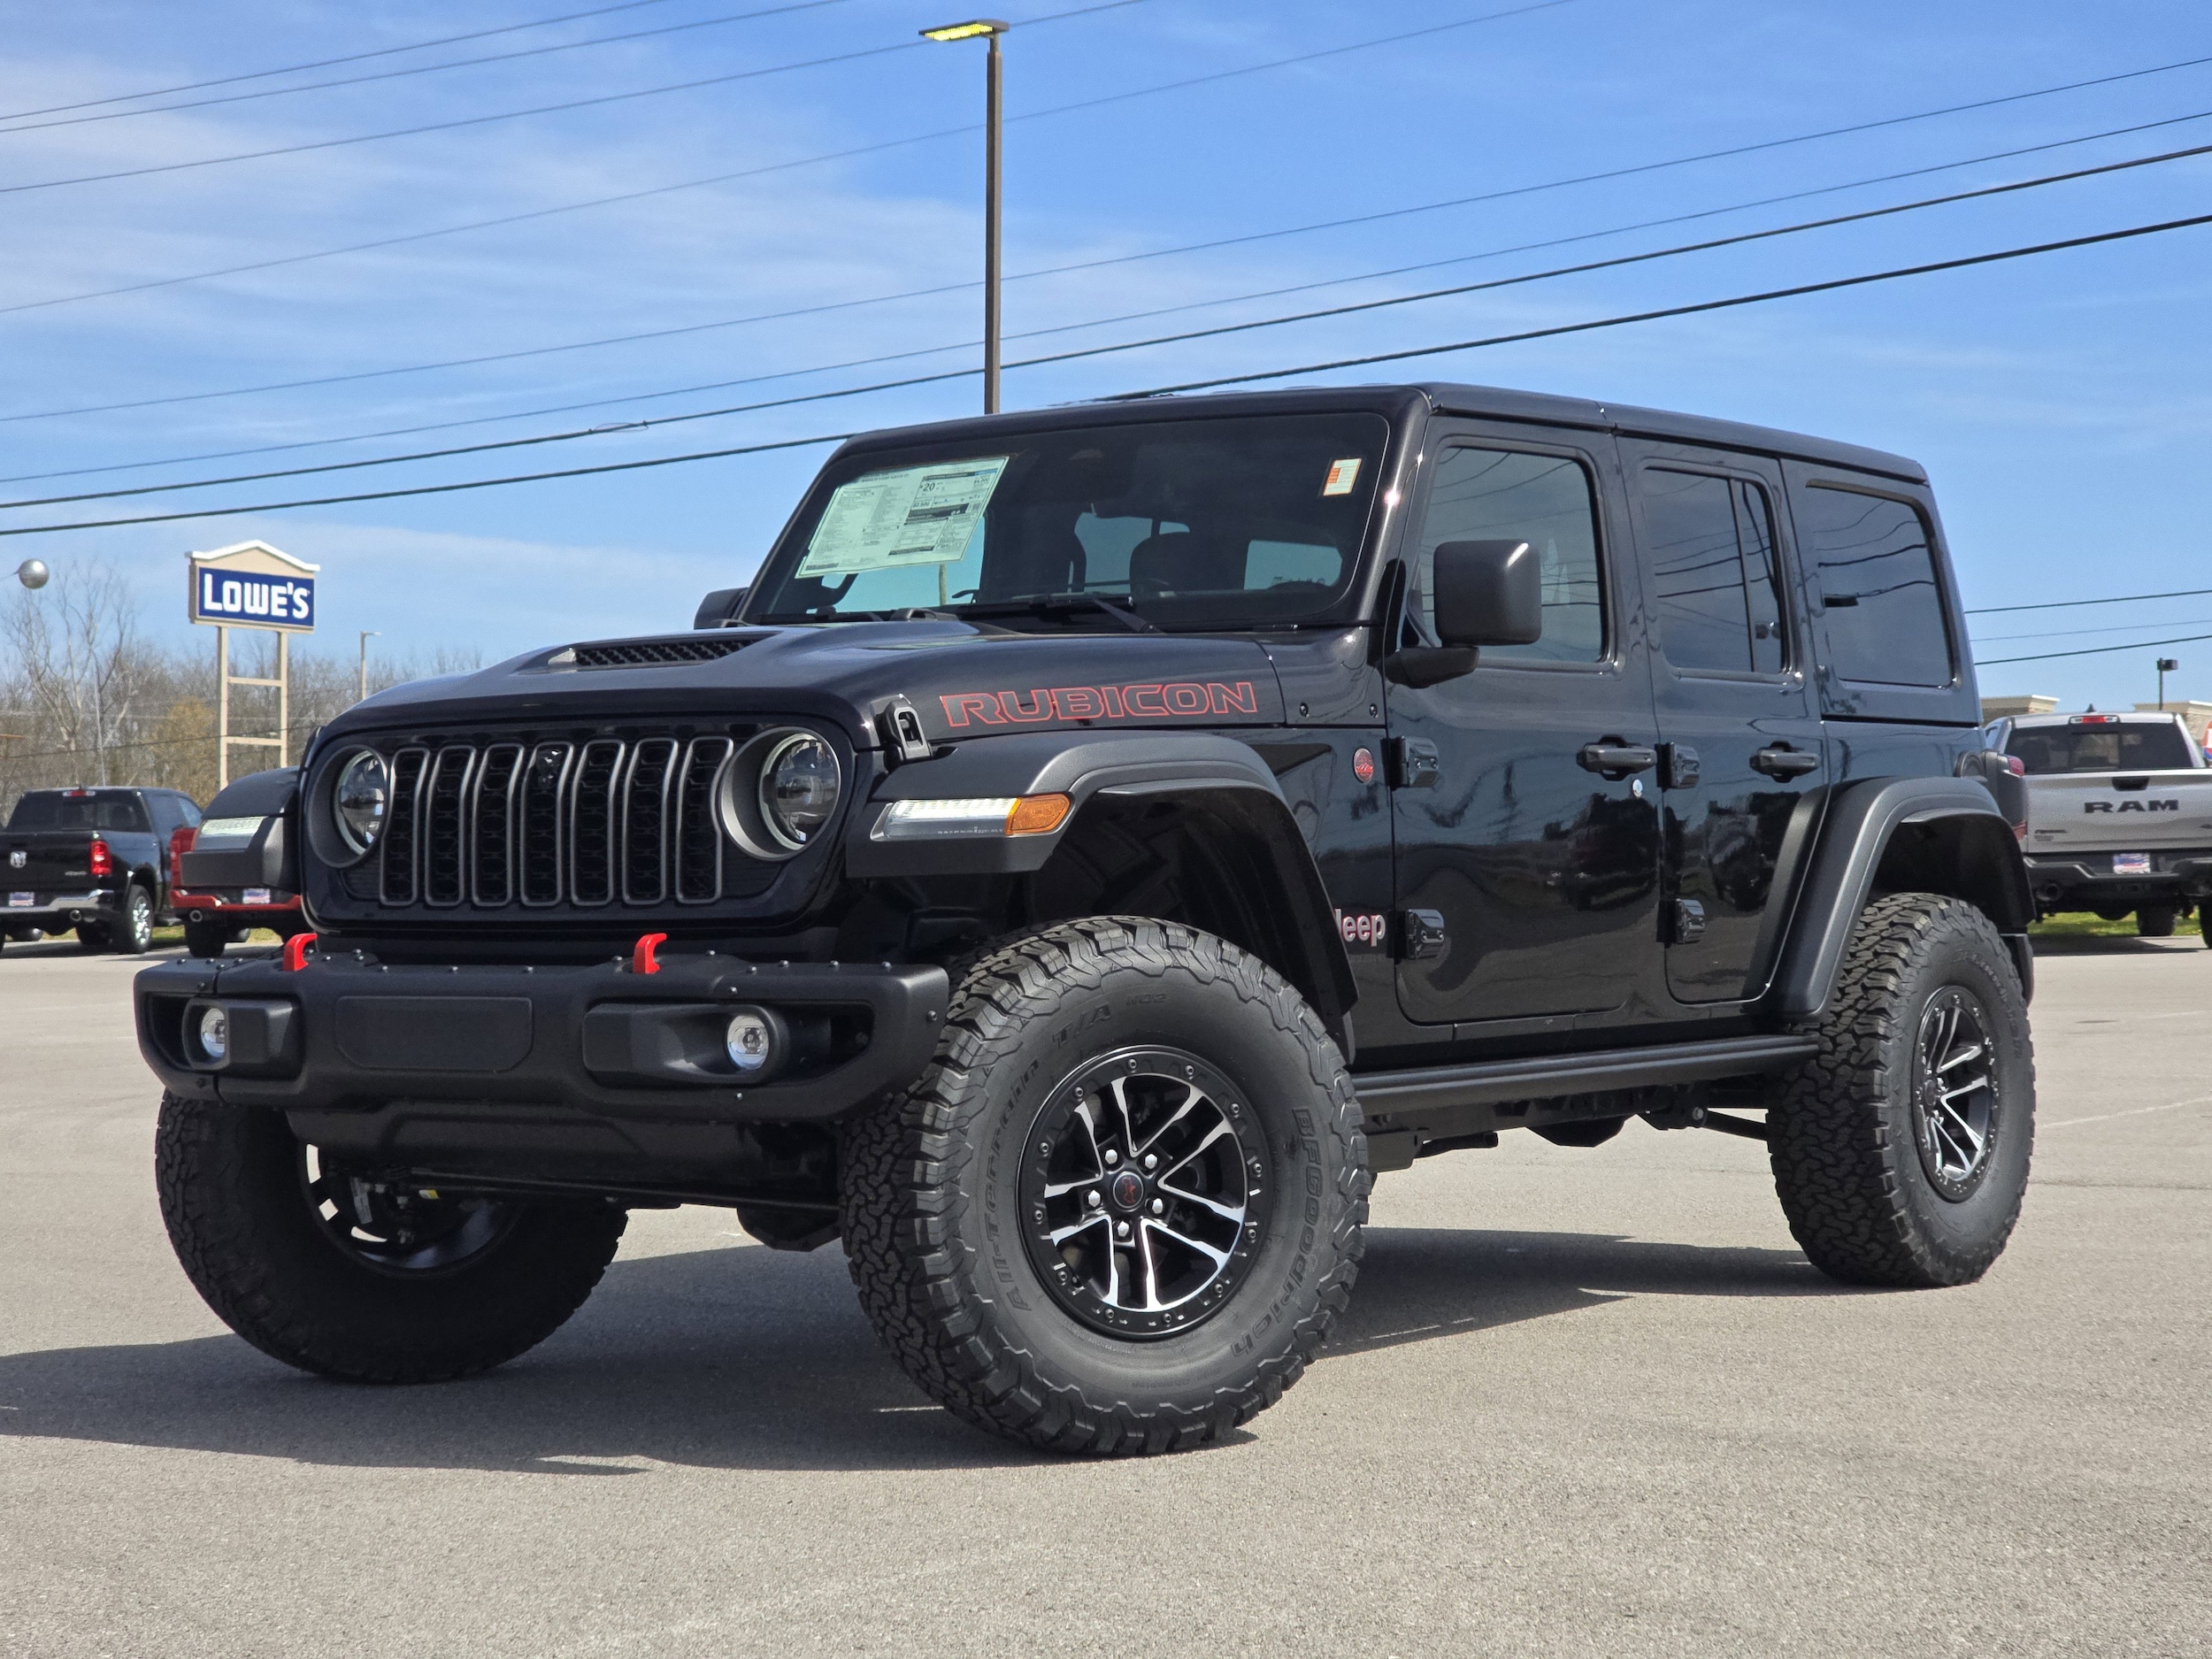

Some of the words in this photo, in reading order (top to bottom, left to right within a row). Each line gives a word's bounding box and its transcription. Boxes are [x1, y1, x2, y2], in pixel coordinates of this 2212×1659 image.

[922, 482, 936, 492] 20
[204, 573, 310, 618] LOWE'S
[940, 681, 1258, 727] RUBICON
[2084, 800, 2178, 813] RAM
[1230, 1107, 1324, 1359] BFGoodrich
